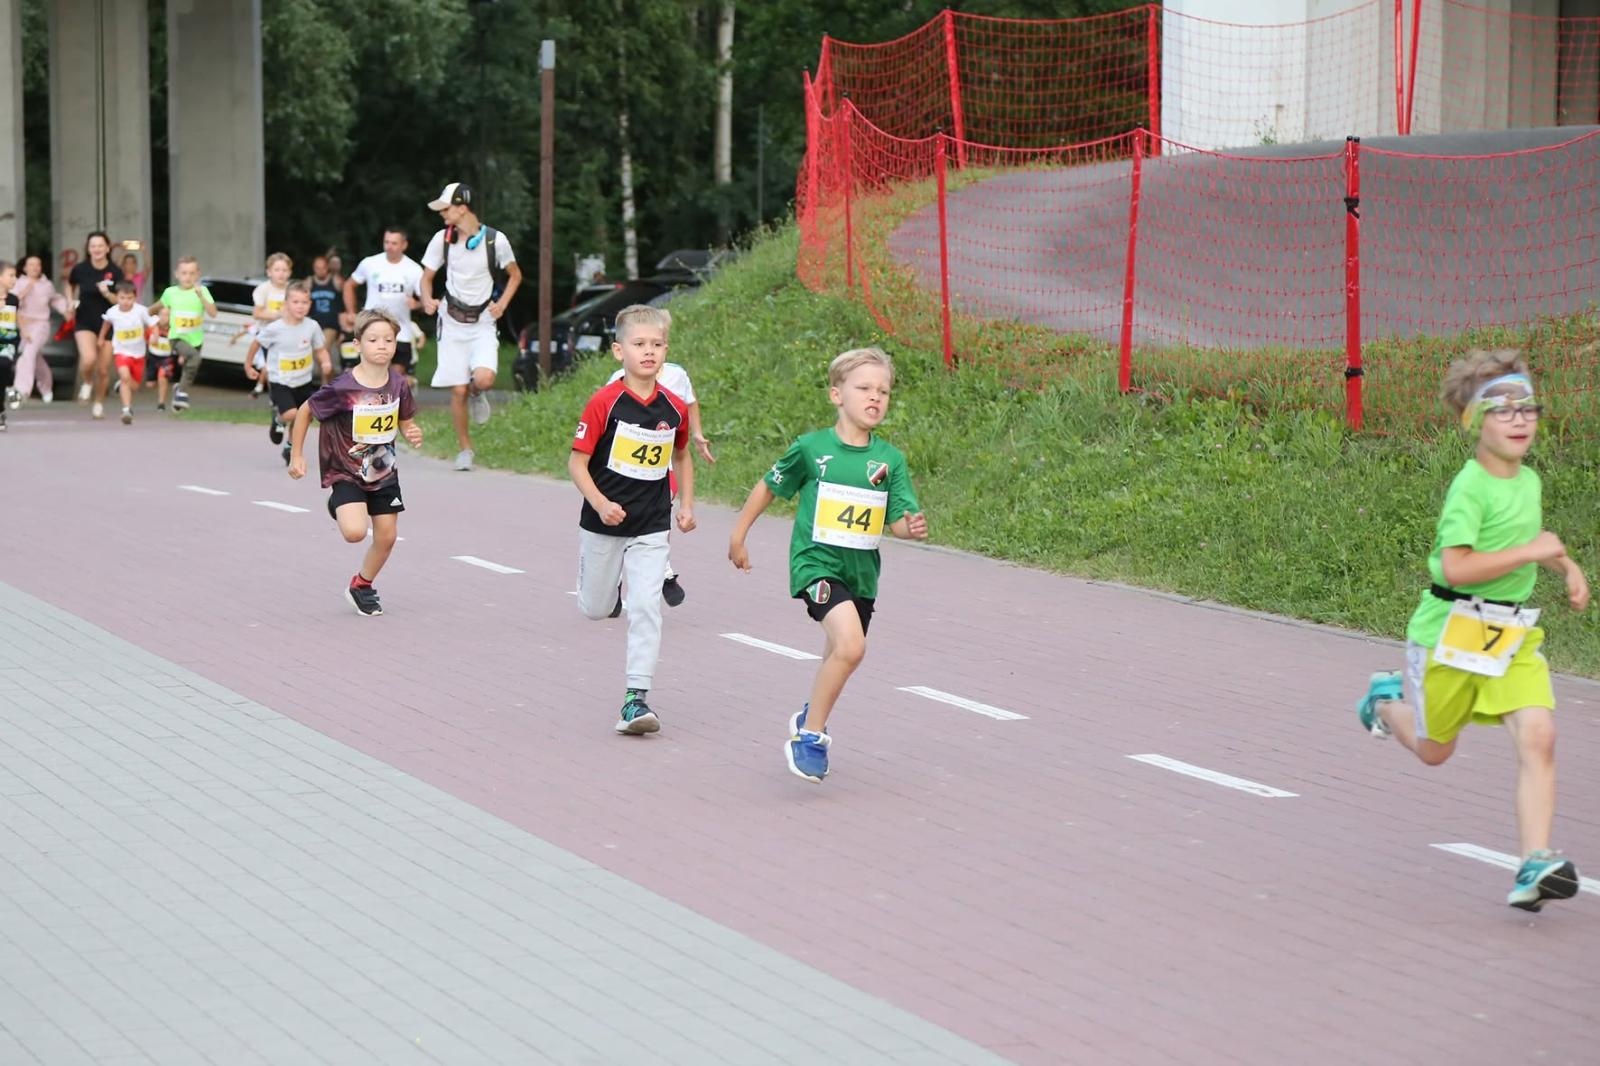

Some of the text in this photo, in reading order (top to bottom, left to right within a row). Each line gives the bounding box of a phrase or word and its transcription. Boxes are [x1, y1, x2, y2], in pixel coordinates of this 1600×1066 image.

[290, 358, 306, 370] 19
[370, 415, 394, 432] 42
[631, 444, 663, 466] 43
[837, 505, 872, 531] 44
[1482, 625, 1504, 651] 7
